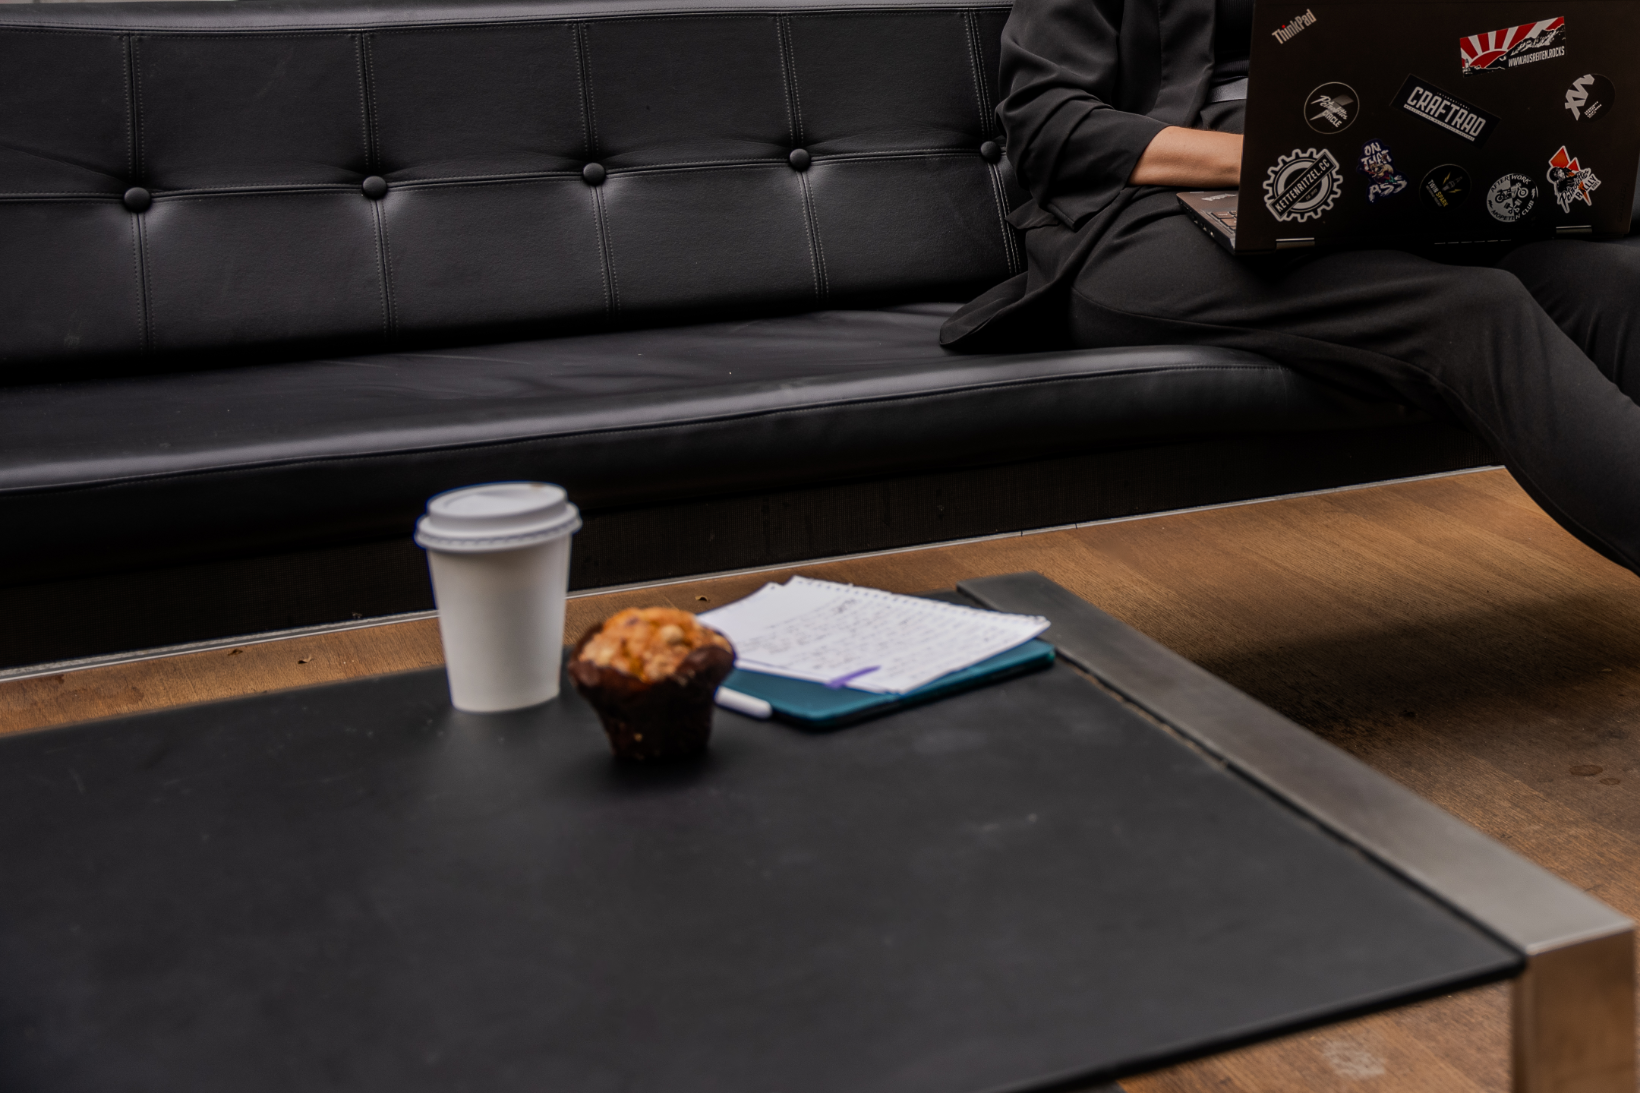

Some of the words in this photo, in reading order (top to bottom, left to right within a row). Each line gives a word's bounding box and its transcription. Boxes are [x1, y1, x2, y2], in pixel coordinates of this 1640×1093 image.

[1272, 8, 1317, 44] ThinkPad
[1508, 46, 1566, 67] WWW.AUSREITEN.ROCKS
[1407, 86, 1486, 137] CRAFTRAD
[1364, 142, 1381, 156] ON
[1275, 159, 1330, 213] KETTENRITZEL.CC
[1511, 174, 1532, 185] WORK
